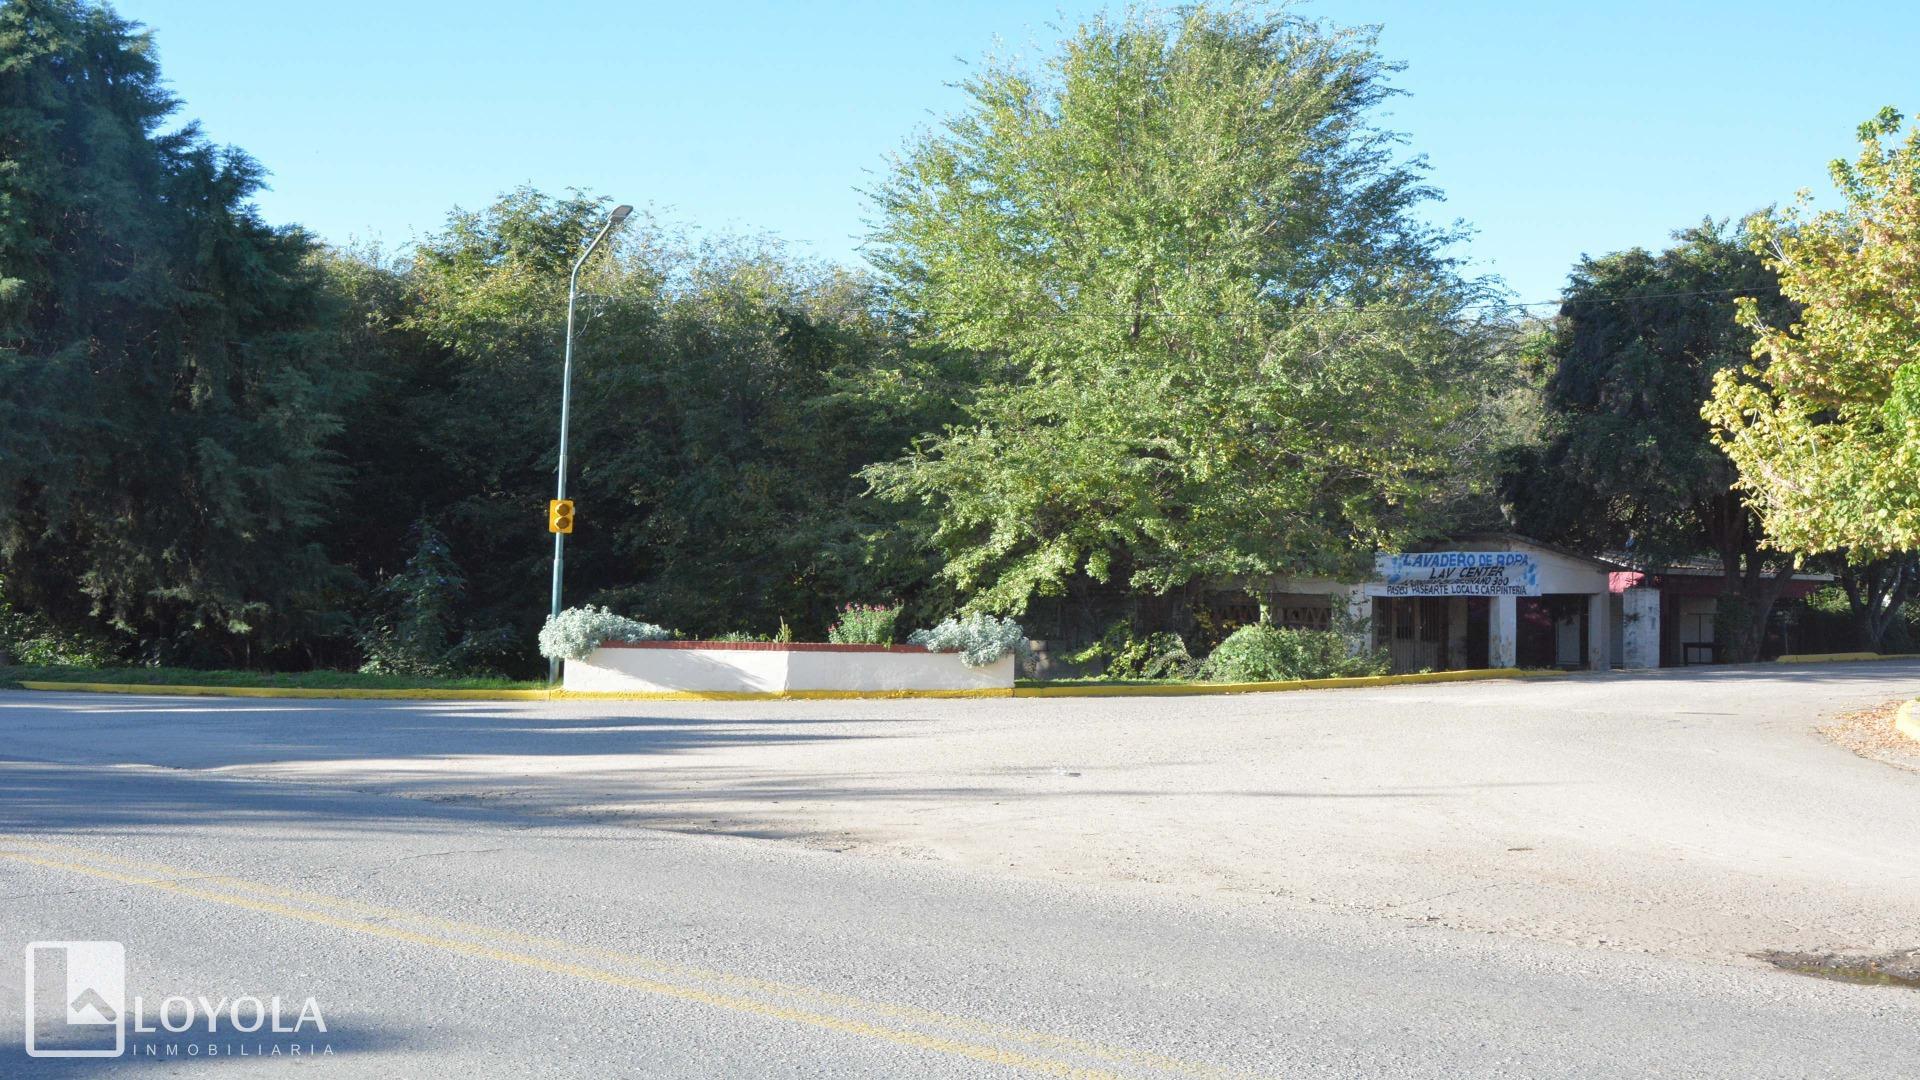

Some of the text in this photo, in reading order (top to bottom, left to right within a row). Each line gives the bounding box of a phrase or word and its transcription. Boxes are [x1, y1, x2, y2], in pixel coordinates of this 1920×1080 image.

[1402, 553, 1529, 567] LAVADERO DE ROPA
[1429, 566, 1504, 579] LAV CENTER
[1411, 584, 1448, 595] PASEARTE
[1481, 585, 1527, 595] CARPINTERIA
